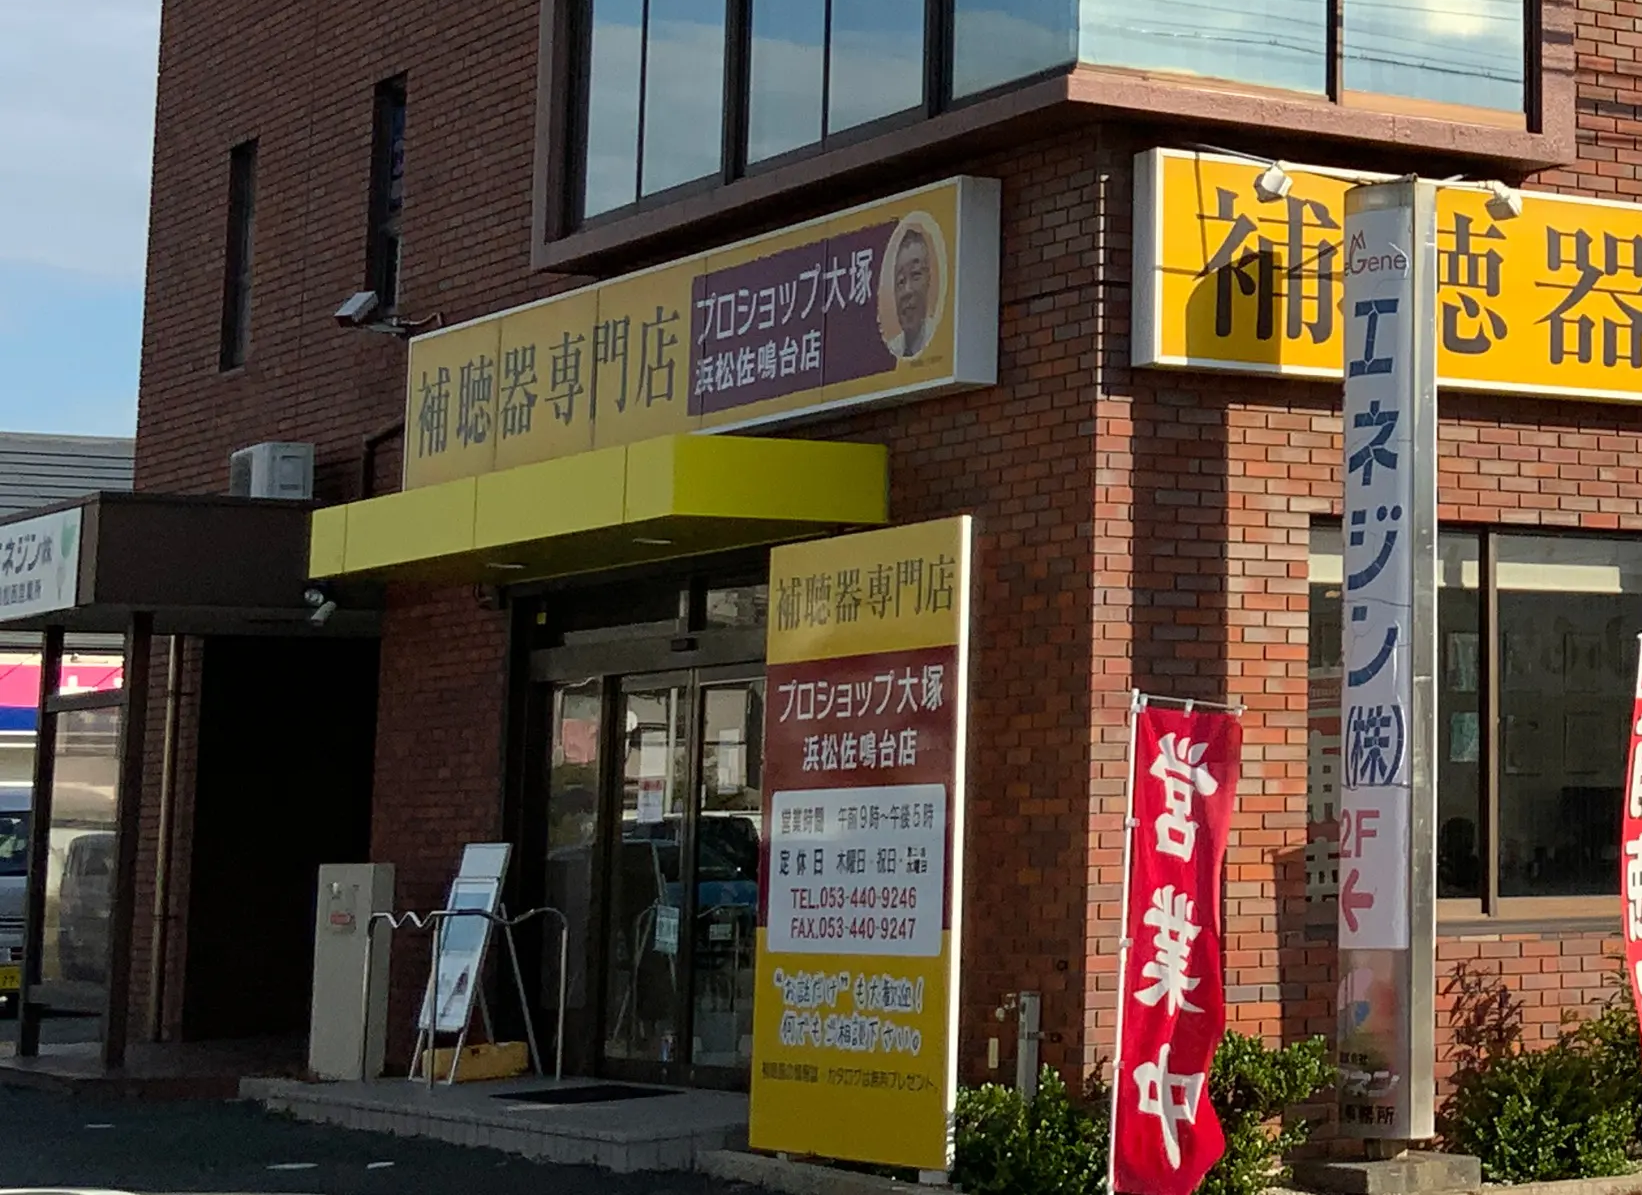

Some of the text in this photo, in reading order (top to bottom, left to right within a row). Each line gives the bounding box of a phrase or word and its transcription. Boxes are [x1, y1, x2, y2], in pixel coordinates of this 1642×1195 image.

[696, 247, 874, 347] プロショップ大塚
[416, 306, 681, 458] 補聴器専門店
[694, 329, 823, 395] 浜松佐鳴台店
[775, 553, 957, 633] 補聴器専門店
[777, 663, 945, 723] プロショップ大塚
[802, 728, 918, 772] 浜松佐鳴台店
[781, 806, 825, 834] 営業時間
[790, 886, 917, 910] TEL.053-440-9246
[790, 916, 917, 942] FAX.053-440-9247
[1134, 731, 1219, 1171] 営業中
